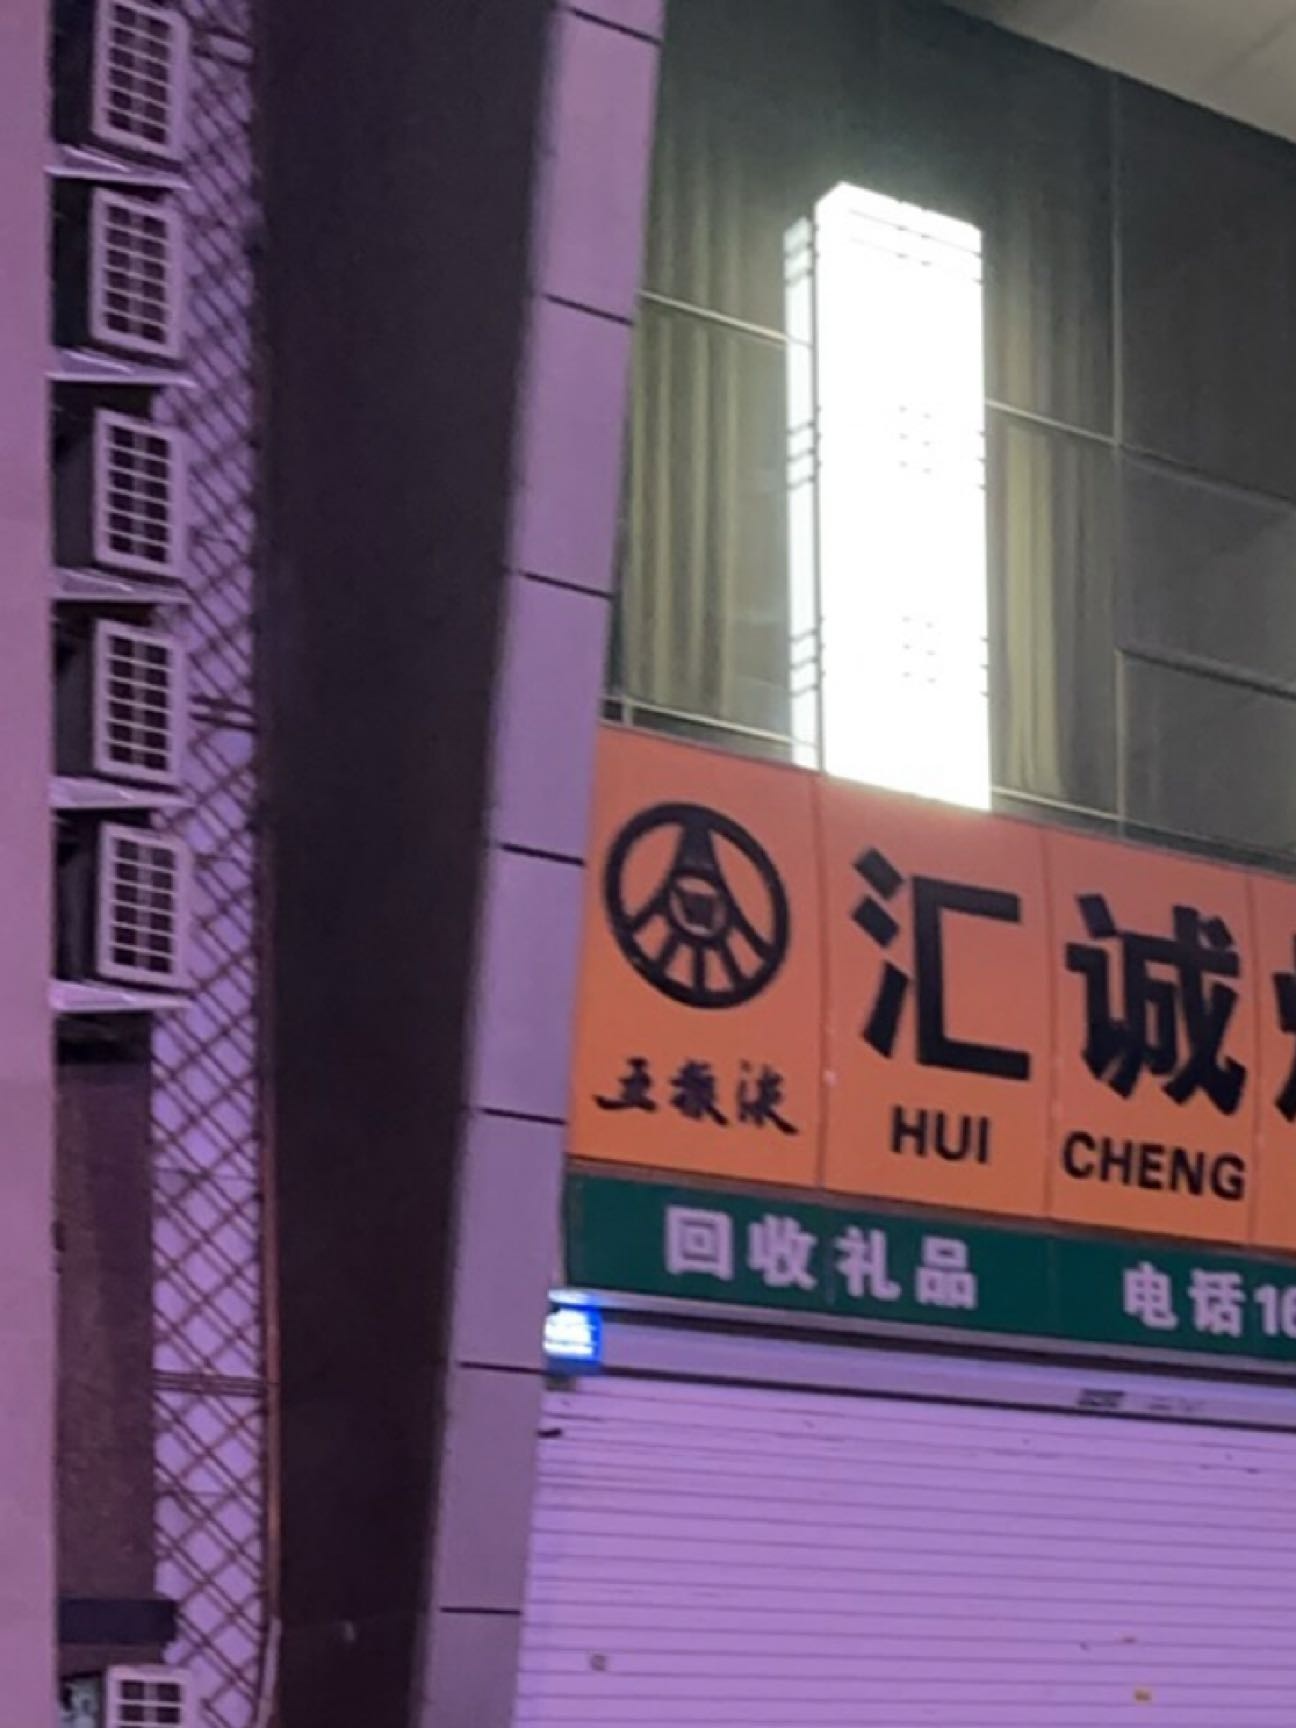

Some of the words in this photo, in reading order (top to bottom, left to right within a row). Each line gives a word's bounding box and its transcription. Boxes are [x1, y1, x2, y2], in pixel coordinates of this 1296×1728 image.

[891, 1106, 990, 1164] HUI
[1062, 1130, 1246, 1201] CHENG
[665, 1207, 978, 1308] 回收礼品
